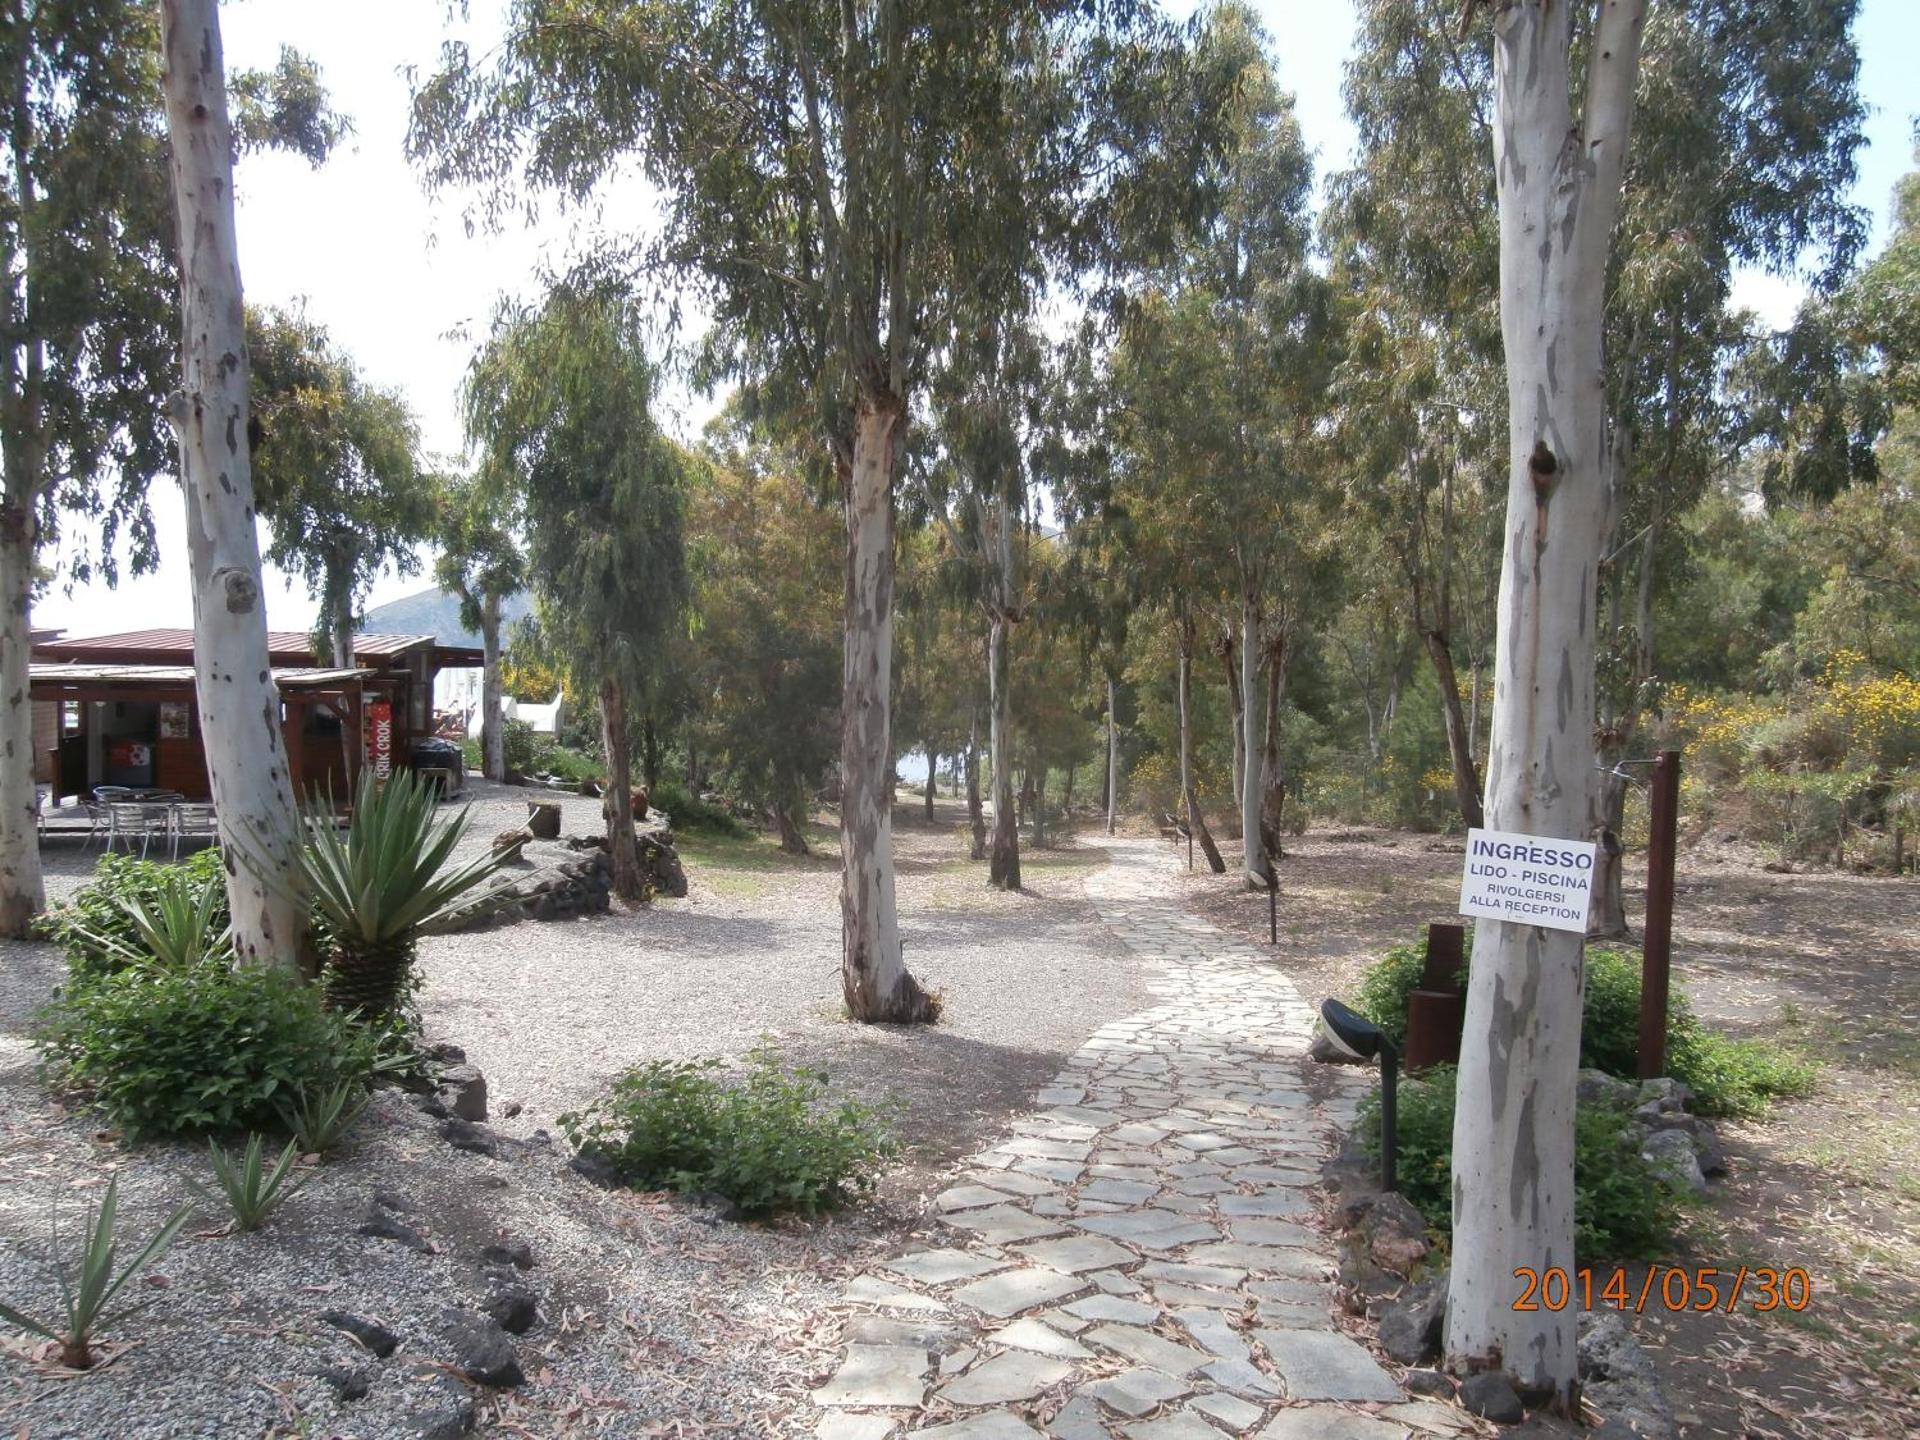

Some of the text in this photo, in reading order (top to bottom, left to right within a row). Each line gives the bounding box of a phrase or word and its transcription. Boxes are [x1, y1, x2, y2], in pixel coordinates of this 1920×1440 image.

[376, 719, 391, 779] CRIK CROK
[1472, 839, 1592, 869] INGRESSO
[1470, 863, 1507, 879] LIDO
[1521, 870, 1588, 890] PISCINA
[1487, 883, 1565, 903] RIVOLGERSI
[1469, 895, 1581, 920] ALLA RECEPTION
